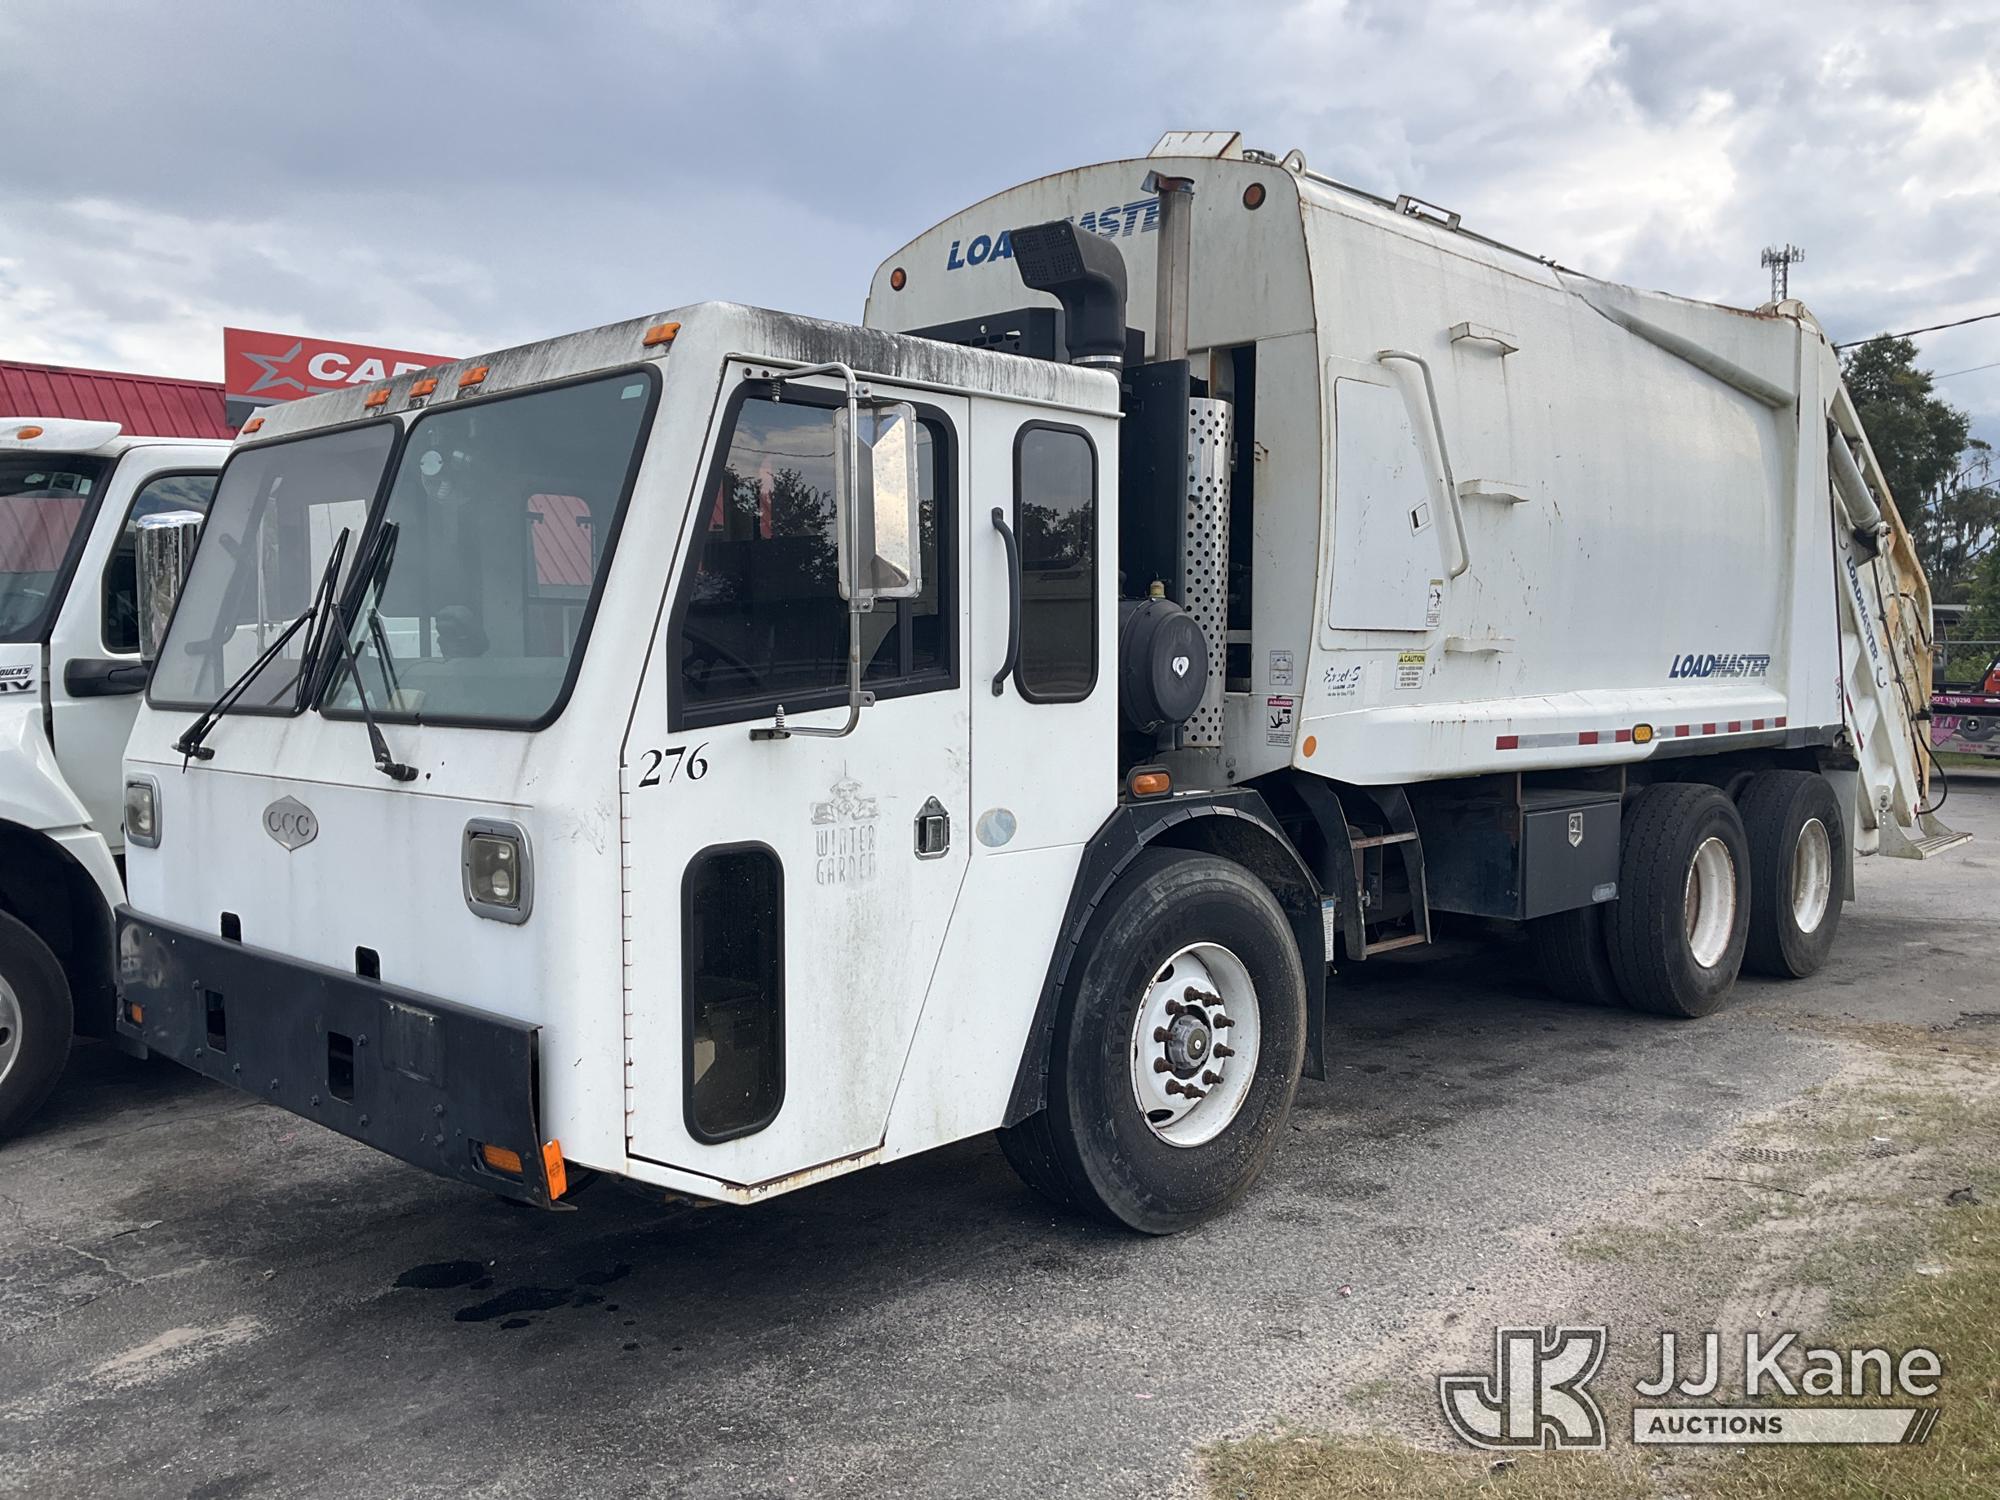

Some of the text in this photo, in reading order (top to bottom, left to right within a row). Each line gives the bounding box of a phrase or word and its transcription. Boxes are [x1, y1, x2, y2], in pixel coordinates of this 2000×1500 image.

[946, 196, 1160, 271] LOAASTE
[1846, 555, 1878, 662] LOADMASTER
[1403, 655, 1425, 663] CAUTION
[1669, 653, 1770, 679] LOADMASTER
[638, 741, 710, 788] 276
[267, 811, 310, 837] CCC
[815, 824, 876, 857] WINTER
